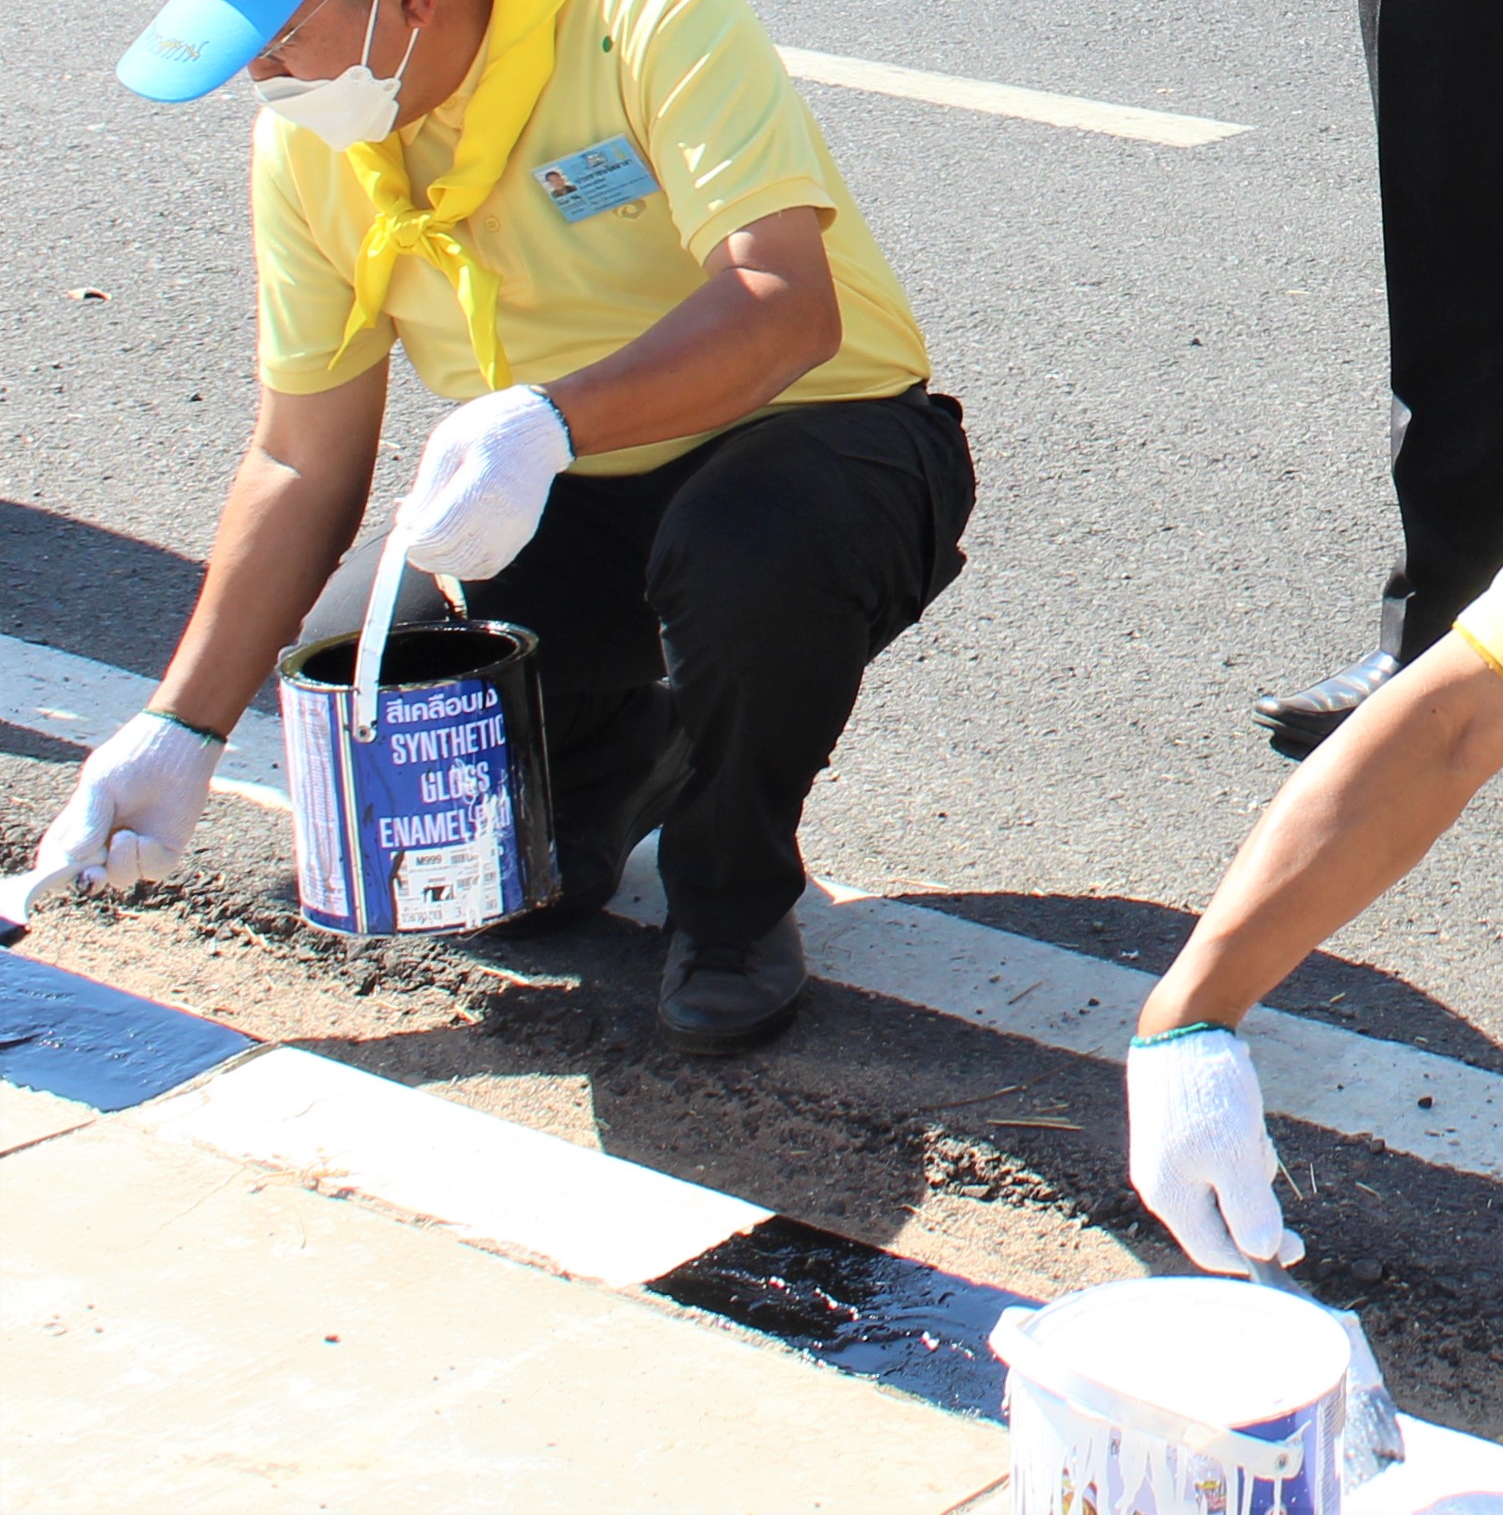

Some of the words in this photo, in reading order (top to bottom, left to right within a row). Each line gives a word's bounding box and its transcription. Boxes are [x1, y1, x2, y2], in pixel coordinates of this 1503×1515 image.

[390, 715, 506, 765] SYNTHETIC
[421, 763, 492, 805] GLOSS
[379, 811, 471, 849] ENAMEL
